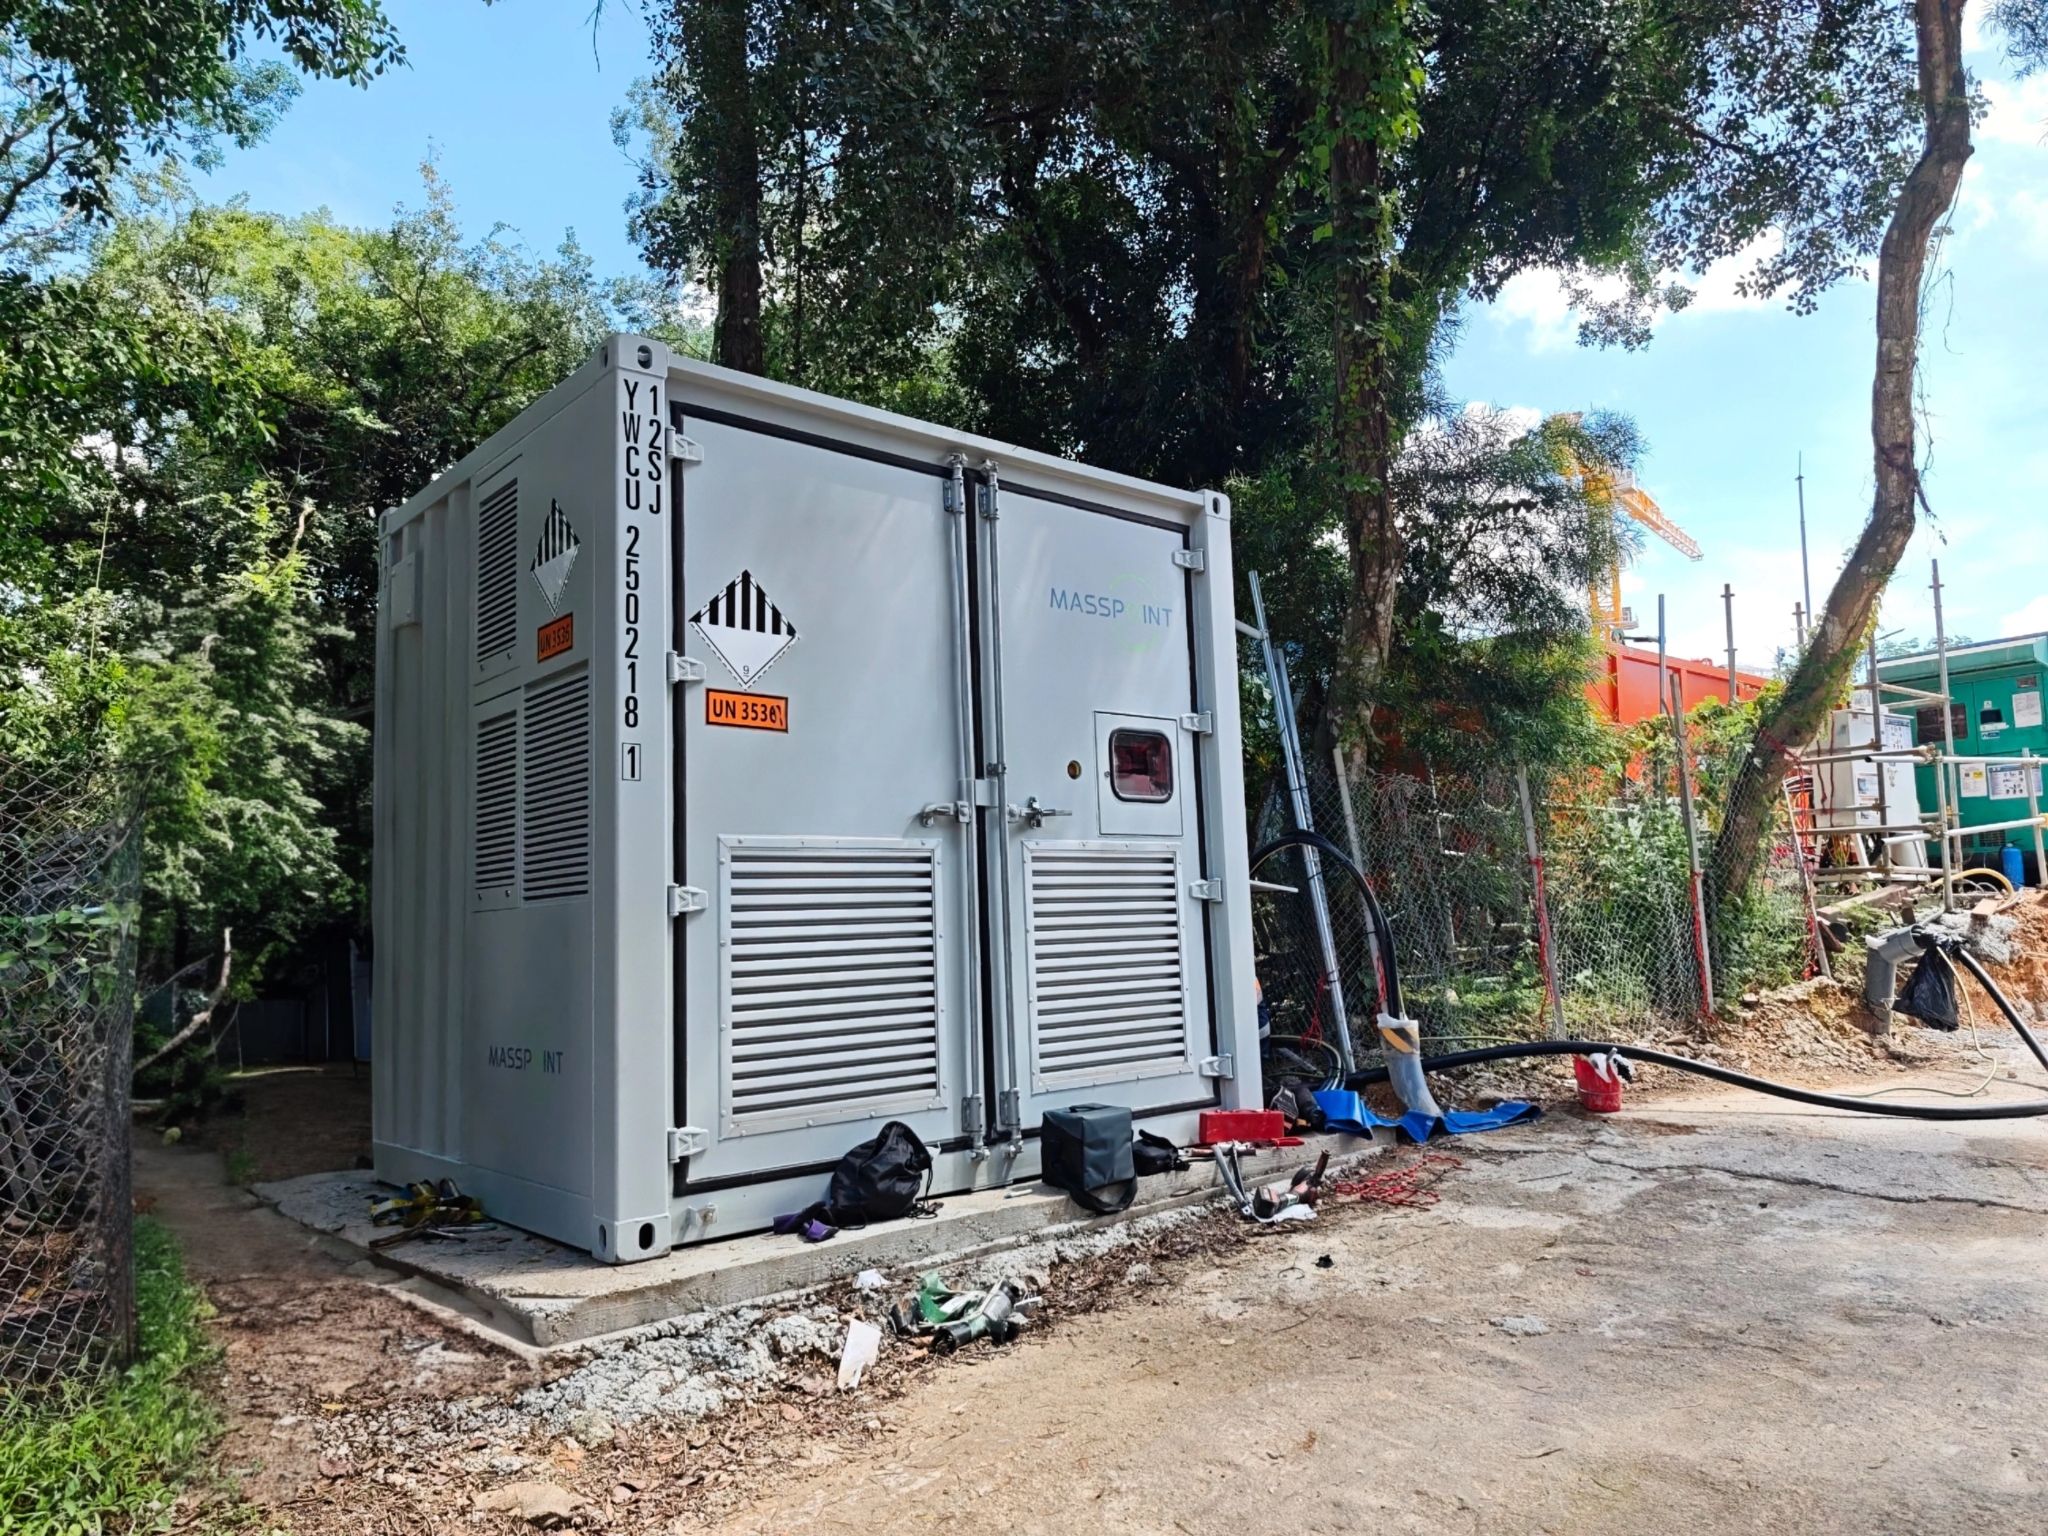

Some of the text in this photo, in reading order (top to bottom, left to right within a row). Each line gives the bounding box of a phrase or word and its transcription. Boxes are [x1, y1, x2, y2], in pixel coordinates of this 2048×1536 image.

[648, 384, 663, 515] 12SJ
[622, 379, 641, 780] YWCU 250218 1
[712, 698, 737, 719] UN
